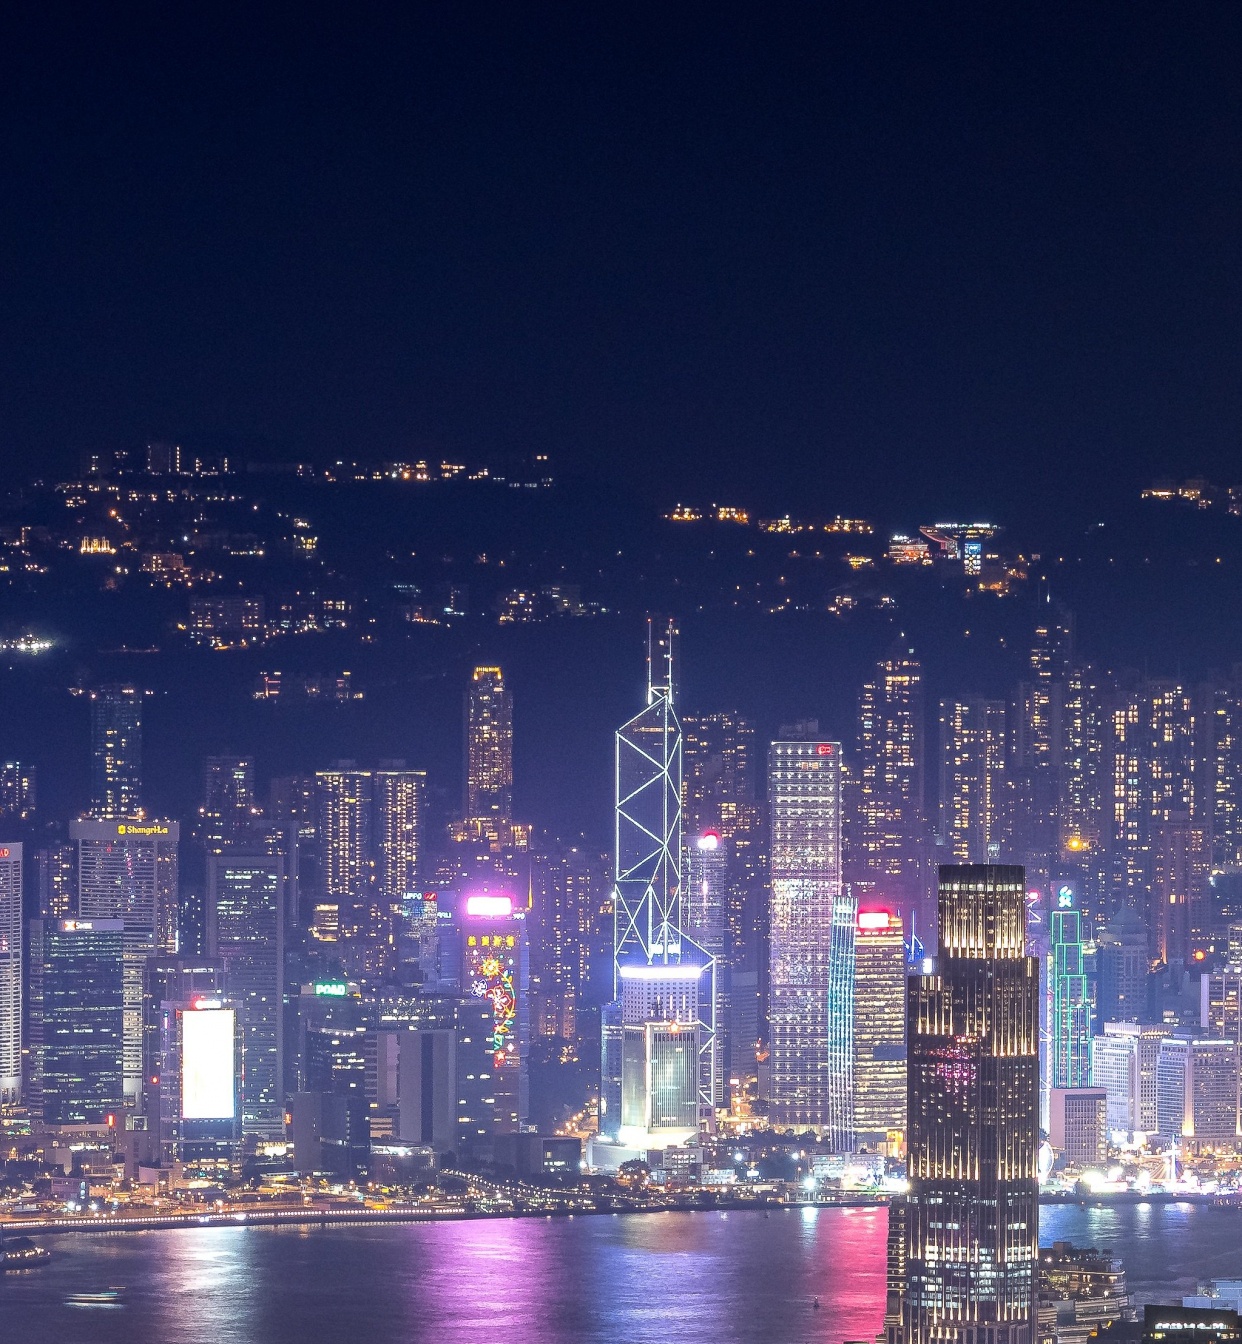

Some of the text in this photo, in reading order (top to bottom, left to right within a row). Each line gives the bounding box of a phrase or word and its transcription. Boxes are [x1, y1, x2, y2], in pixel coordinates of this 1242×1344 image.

[127, 825, 168, 835] Shangri-La
[403, 892, 422, 900] LIPPO
[315, 984, 345, 995] POAD
